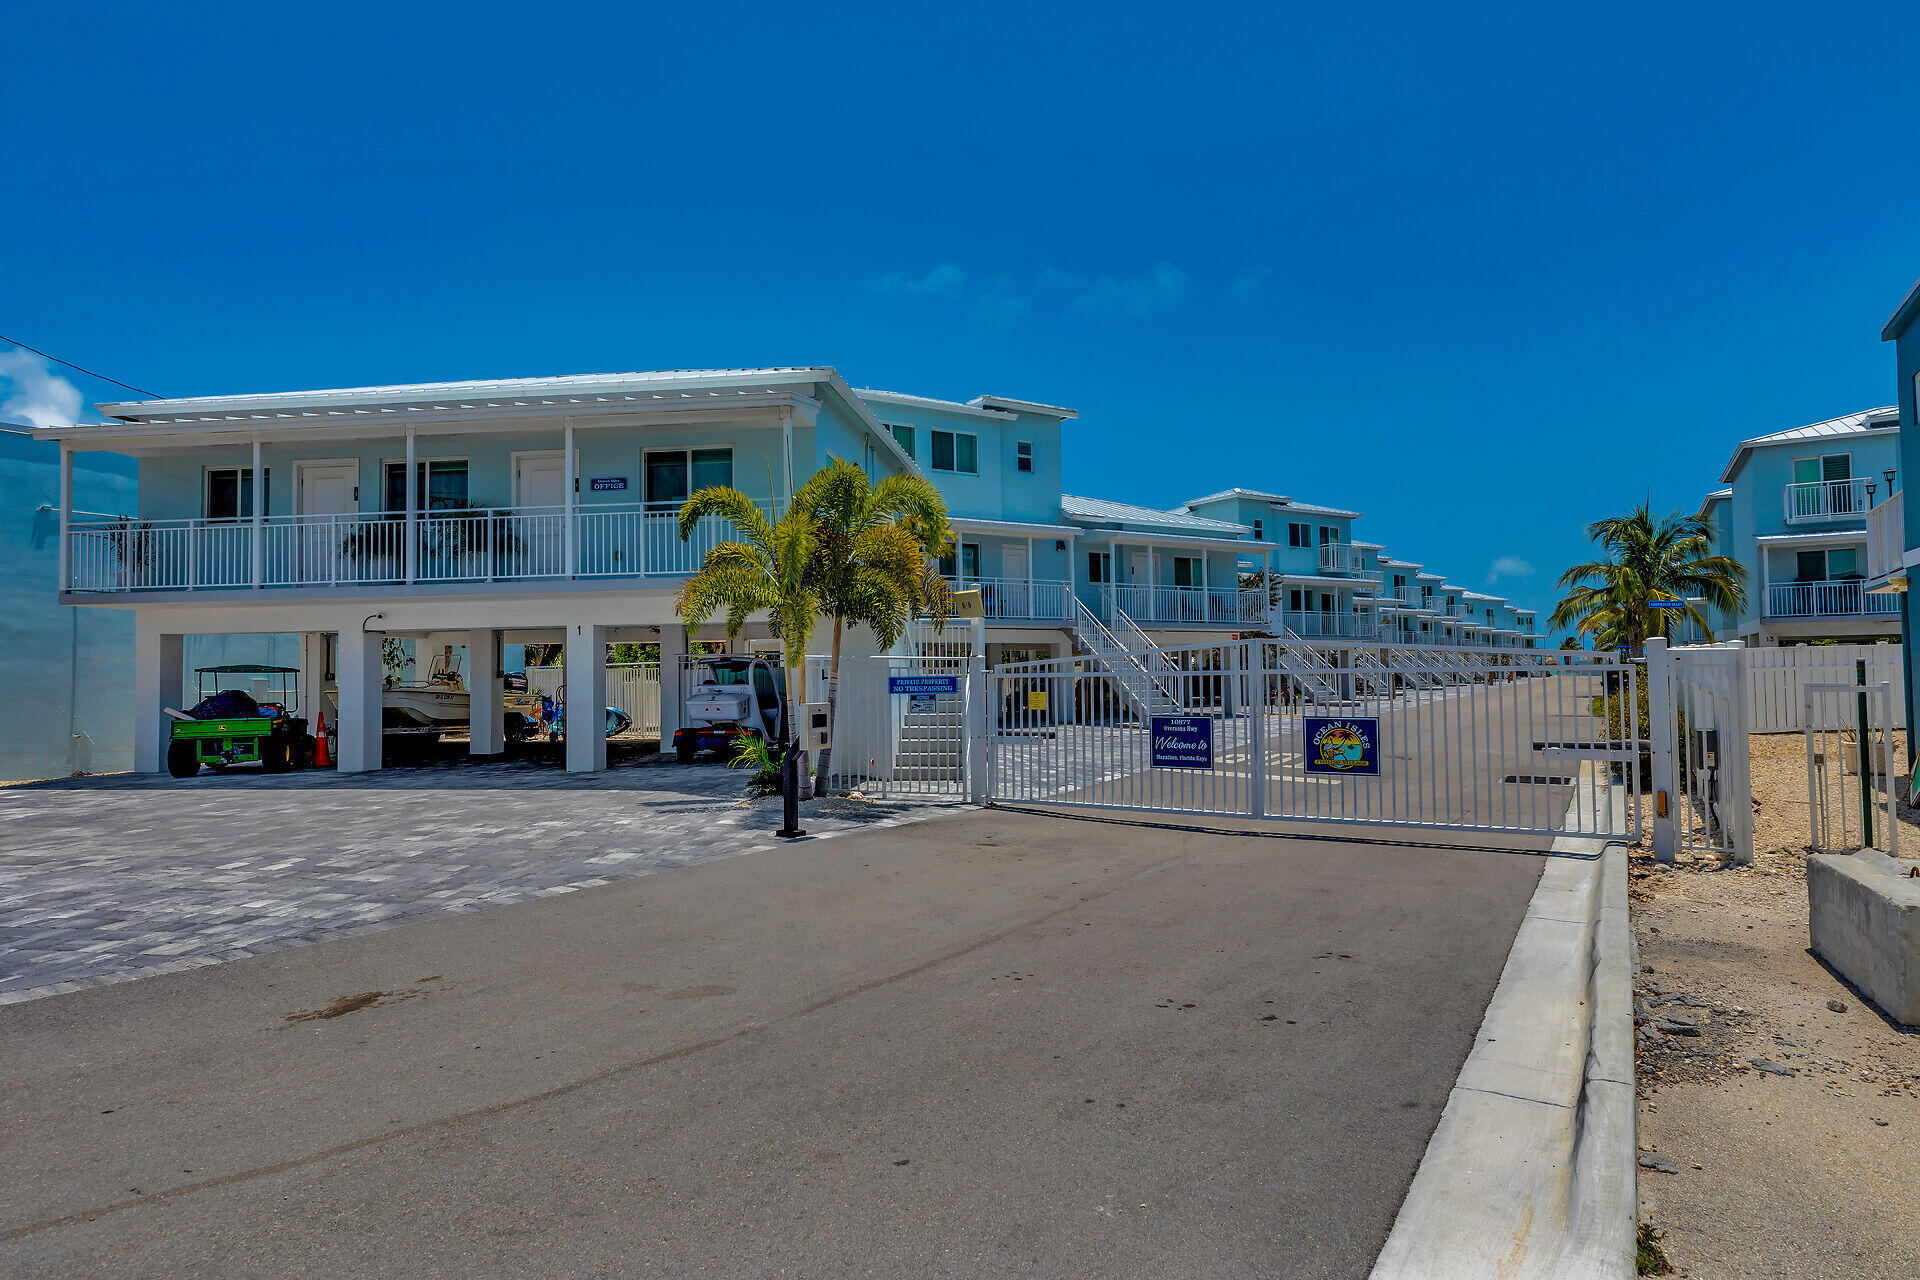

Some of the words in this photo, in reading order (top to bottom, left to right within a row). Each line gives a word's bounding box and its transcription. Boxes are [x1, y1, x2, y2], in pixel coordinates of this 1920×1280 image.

[577, 624, 581, 636] 1
[920, 678, 950, 686] PROPERTY
[1186, 725, 1198, 733] Hwy
[1312, 720, 1342, 746] OCEAN
[1345, 721, 1371, 749] ISLES
[1155, 735, 1197, 750] Welcome
[1198, 739, 1208, 750] to
[1196, 755, 1208, 763] Keys
